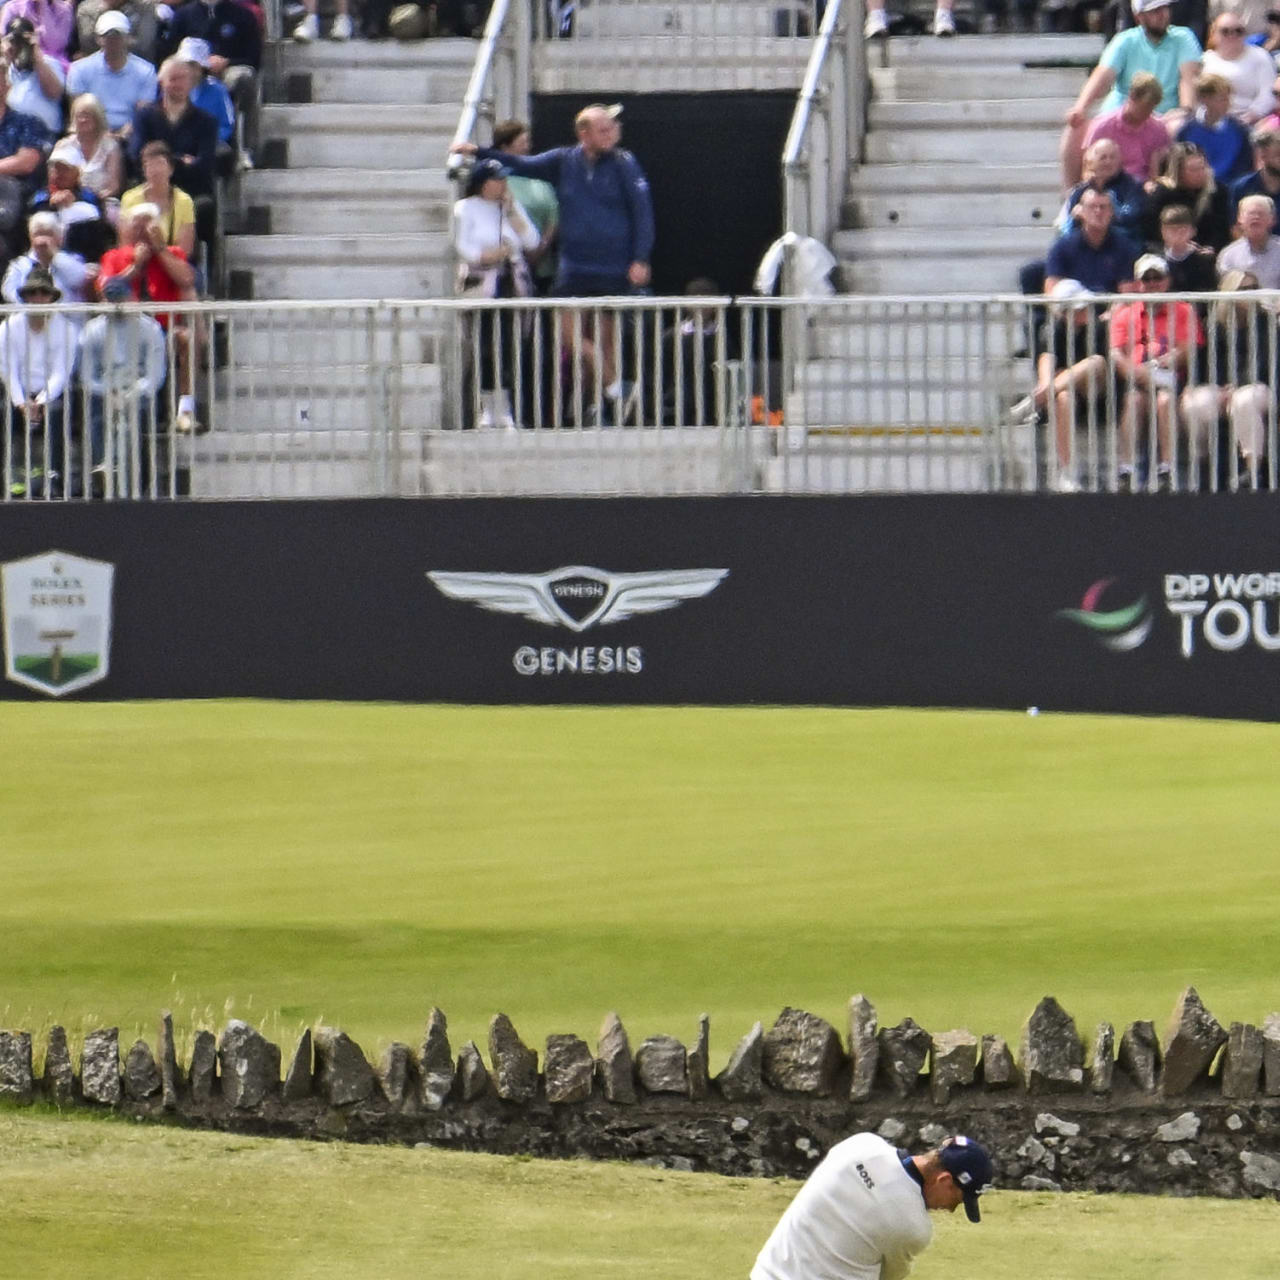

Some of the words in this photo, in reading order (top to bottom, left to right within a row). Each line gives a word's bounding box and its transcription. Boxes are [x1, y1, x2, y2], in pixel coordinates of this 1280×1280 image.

[1165, 573, 1210, 599] DP
[513, 645, 642, 675] GENESIS
[856, 1163, 875, 1190] BOSS
